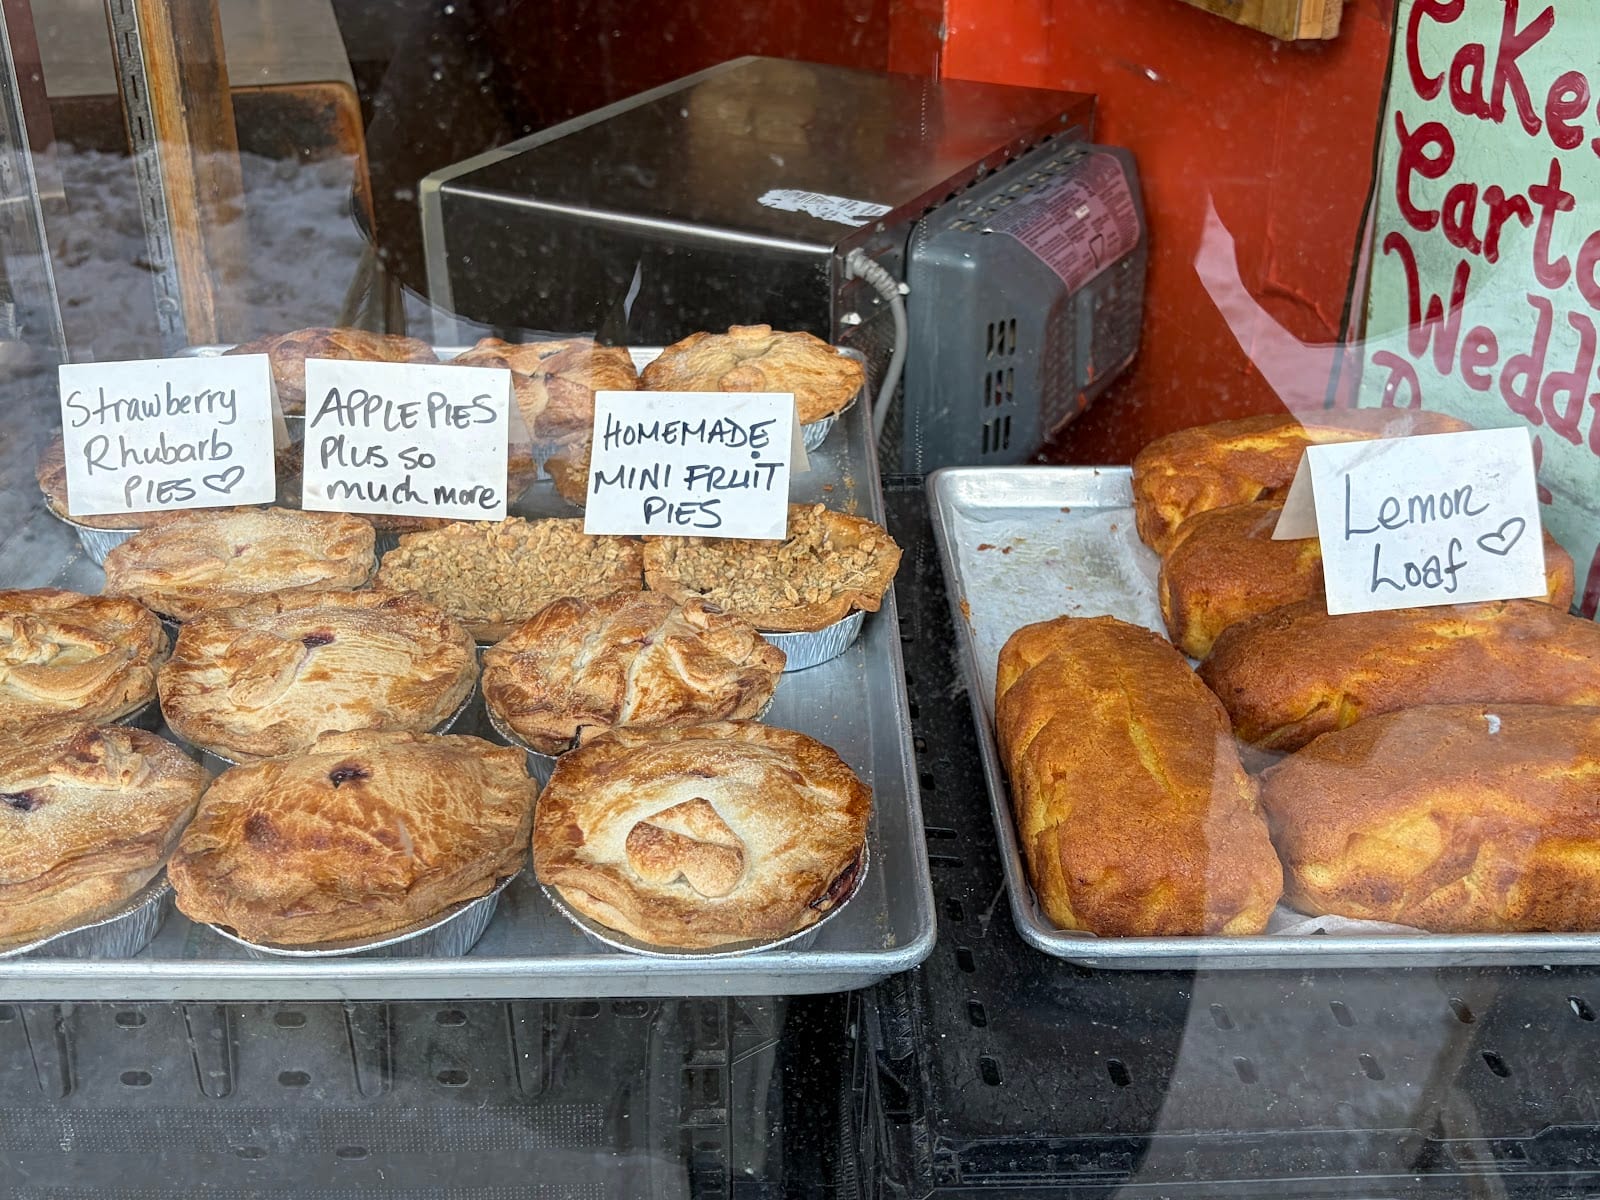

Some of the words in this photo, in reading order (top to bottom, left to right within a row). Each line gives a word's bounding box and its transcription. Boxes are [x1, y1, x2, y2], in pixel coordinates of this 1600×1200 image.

[66, 382, 237, 427] Strawberry
[310, 387, 421, 432] APPLE
[427, 391, 498, 429] PIES
[83, 428, 233, 475] Rhubarb
[603, 412, 777, 451] HOMEMADE
[124, 475, 196, 507] PIES
[327, 474, 428, 505] much
[433, 484, 501, 509] more
[593, 463, 671, 494] MINI
[683, 451, 785, 492] FRUIT
[643, 496, 722, 528] PIES
[1345, 473, 1490, 541] Lemon
[1371, 537, 1468, 593] Loaf
